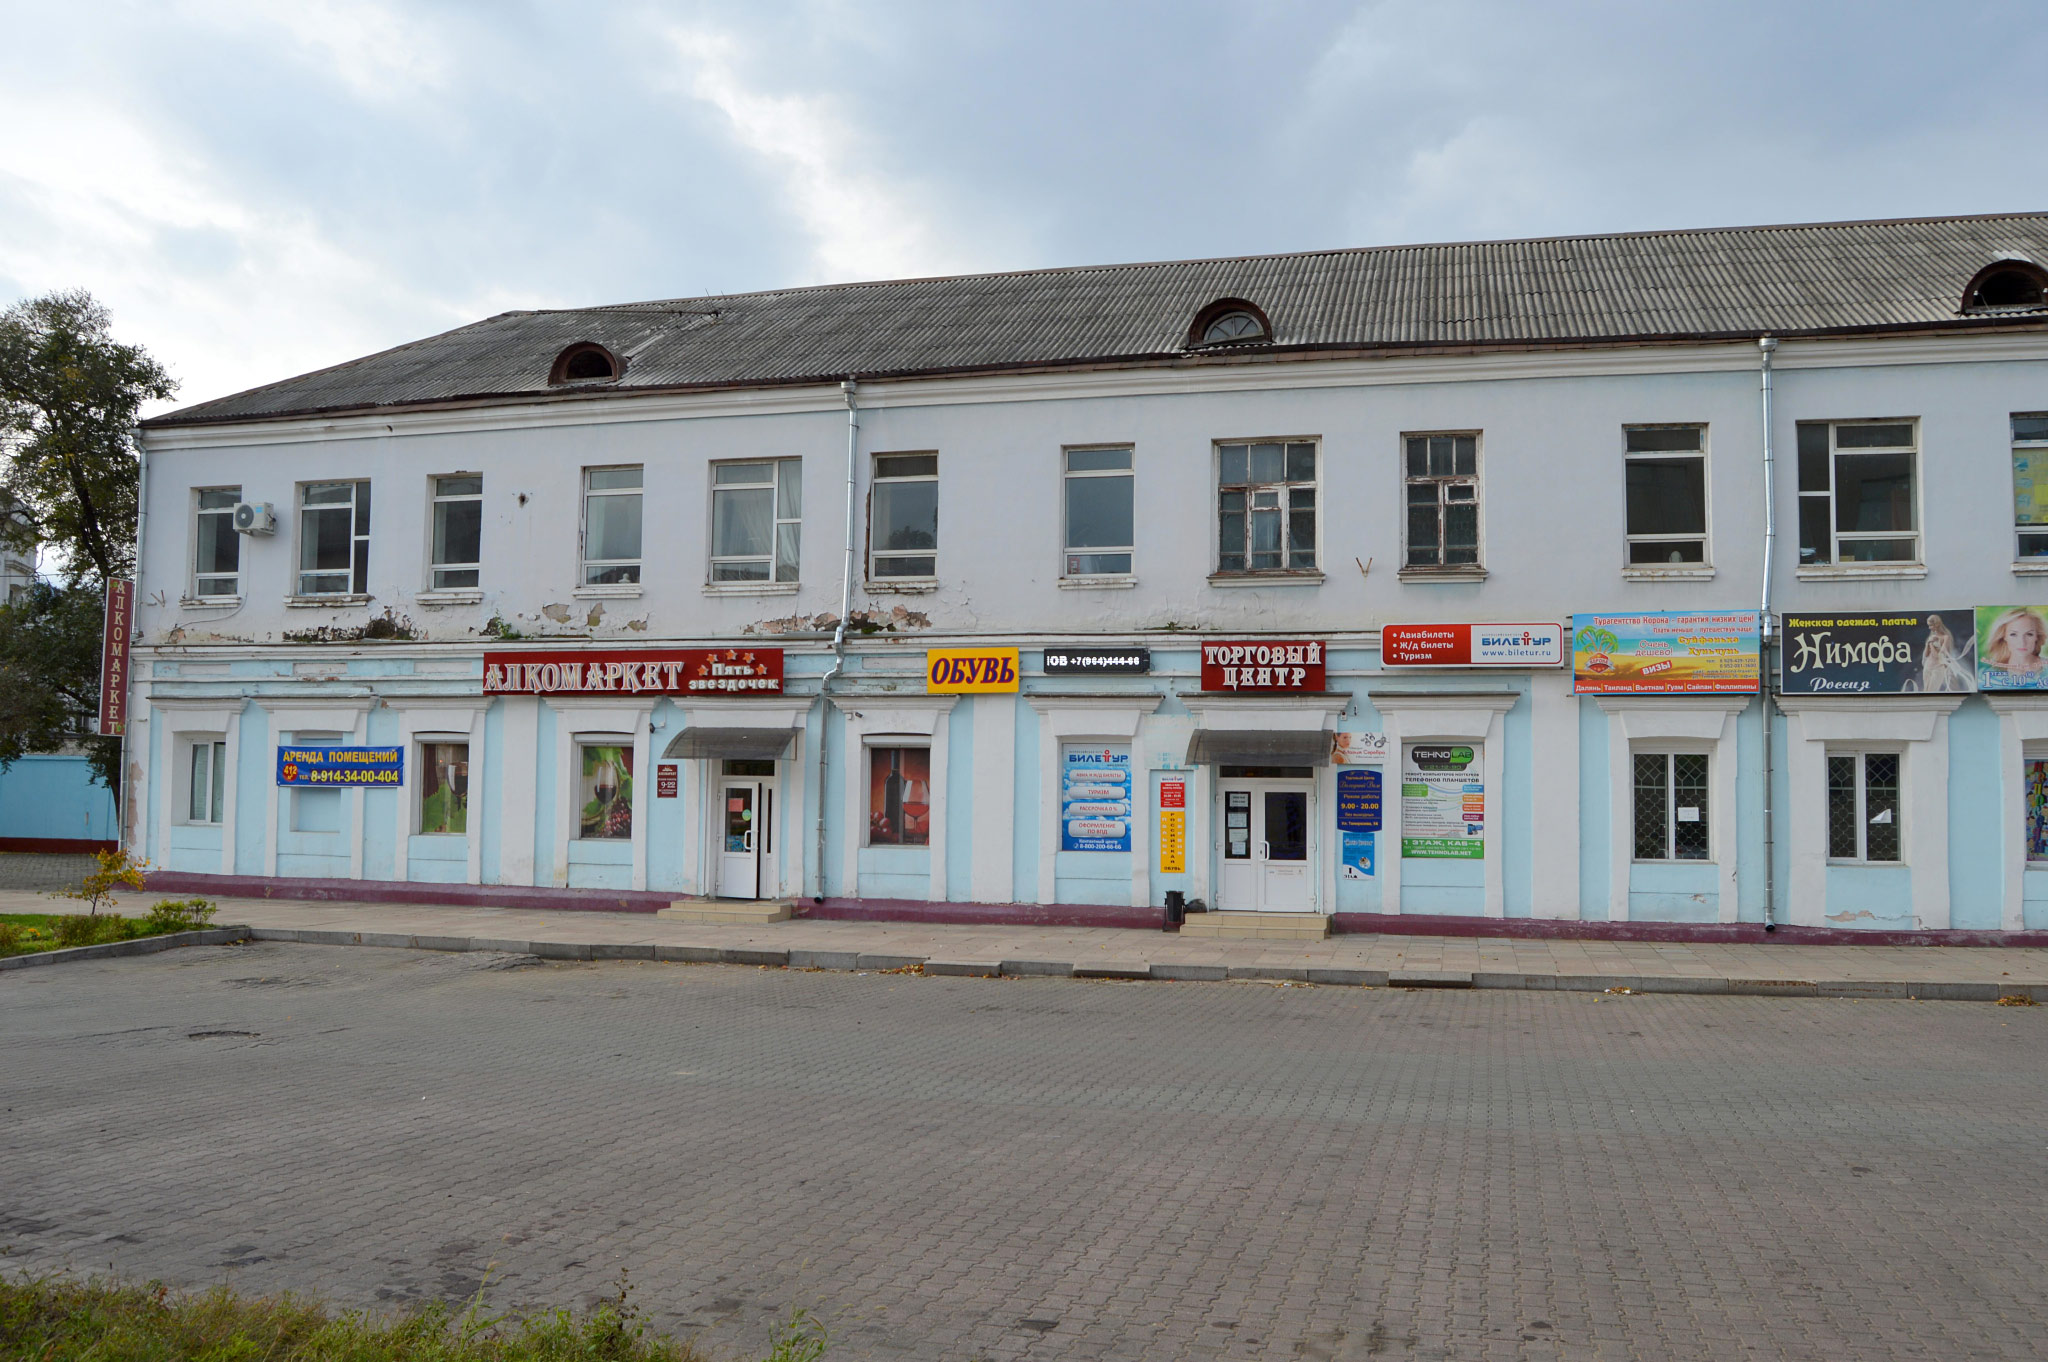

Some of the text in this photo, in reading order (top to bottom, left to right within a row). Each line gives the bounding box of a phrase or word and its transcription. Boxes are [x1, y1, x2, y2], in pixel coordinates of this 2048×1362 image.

[1593, 616, 1641, 626] Турагентство
[1642, 616, 1669, 626] Корона
[1677, 616, 1709, 625] гарантия
[1739, 615, 1754, 624] цен!
[1788, 617, 1918, 628] Женская одежда, платья
[1400, 630, 1455, 640] Авиабилеты
[1482, 634, 1552, 646] БИЛЕТУР
[1399, 641, 1454, 651] Ж/д билеты
[1639, 640, 1669, 649] Очень
[108, 580, 126, 735] АЛКОМАРКЕТ
[1204, 641, 1322, 666] ТОРГОВЫЙ
[1400, 652, 1432, 661] Туризм
[1635, 648, 1673, 657] дешево!
[1688, 647, 1740, 656] Хуньчунь
[1790, 631, 1913, 673] Нимфа
[711, 662, 755, 677] Пять
[930, 655, 1016, 685] ОБУВЬ
[483, 661, 685, 694] АЛКОМАРКЕТ
[1222, 667, 1307, 692] ЦЕНТР
[1982, 671, 1993, 688] 1
[688, 678, 779, 692] звездочек
[1576, 684, 1602, 692] Далянь
[1667, 684, 1684, 692] Гуам
[1687, 683, 1713, 691] Сайпан
[1809, 677, 1871, 691] Россия
[282, 749, 398, 764] АРЕНДА ПОМЕЩЕНИЙ
[1068, 751, 1129, 763] БИЛЕТУР
[1414, 750, 1473, 759] TEHNOLAB
[283, 765, 298, 775] 412
[310, 770, 399, 783] 8-914-34-00-404
